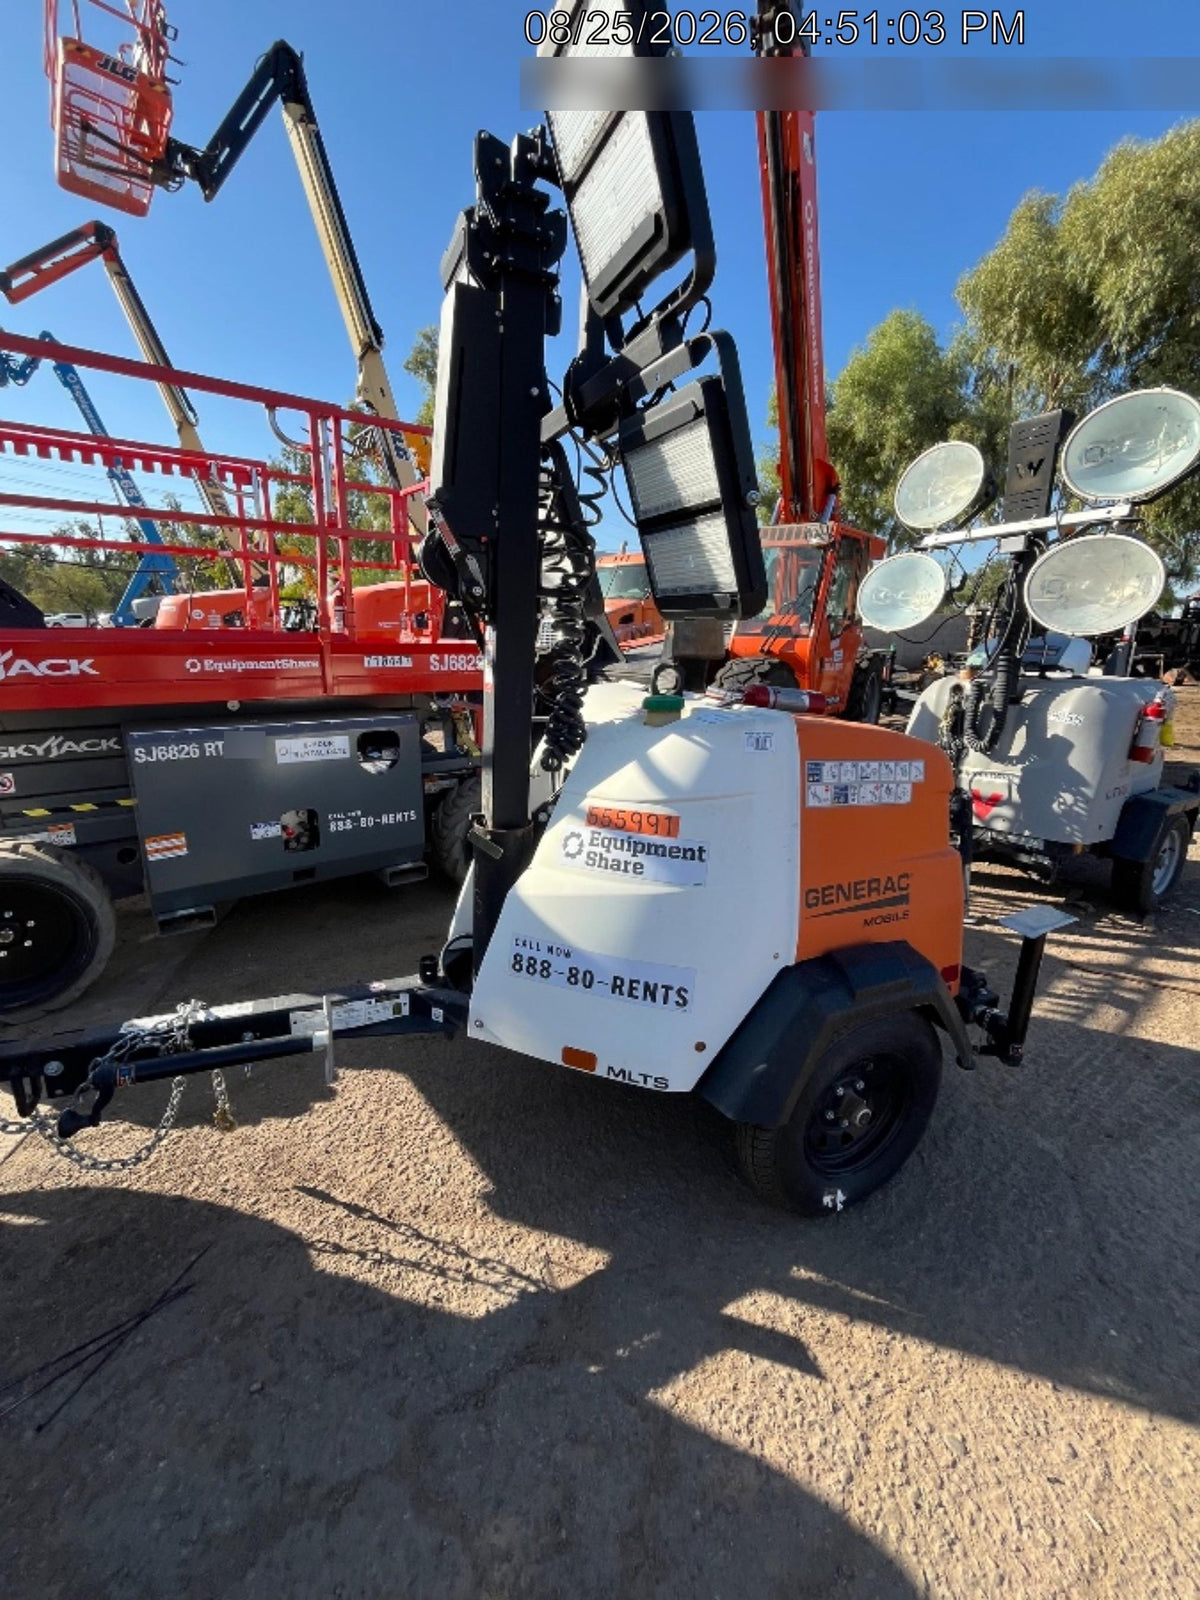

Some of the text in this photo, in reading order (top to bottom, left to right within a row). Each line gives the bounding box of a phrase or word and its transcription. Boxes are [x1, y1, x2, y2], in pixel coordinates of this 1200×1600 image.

[97, 57, 138, 82] JLG
[203, 659, 319, 673] EquipmentShare
[0, 736, 122, 759] SKYJACK
[134, 744, 200, 763] SJ6826
[329, 810, 417, 832] 888-80-RENTS
[588, 830, 706, 862] Equipment
[585, 851, 645, 875] Share
[804, 872, 910, 909] GENERAC
[863, 910, 910, 927] MOBILE
[514, 937, 572, 958] CALL NOW
[511, 952, 689, 1008] 888-80-RENTS
[607, 1065, 669, 1090] MLTS
